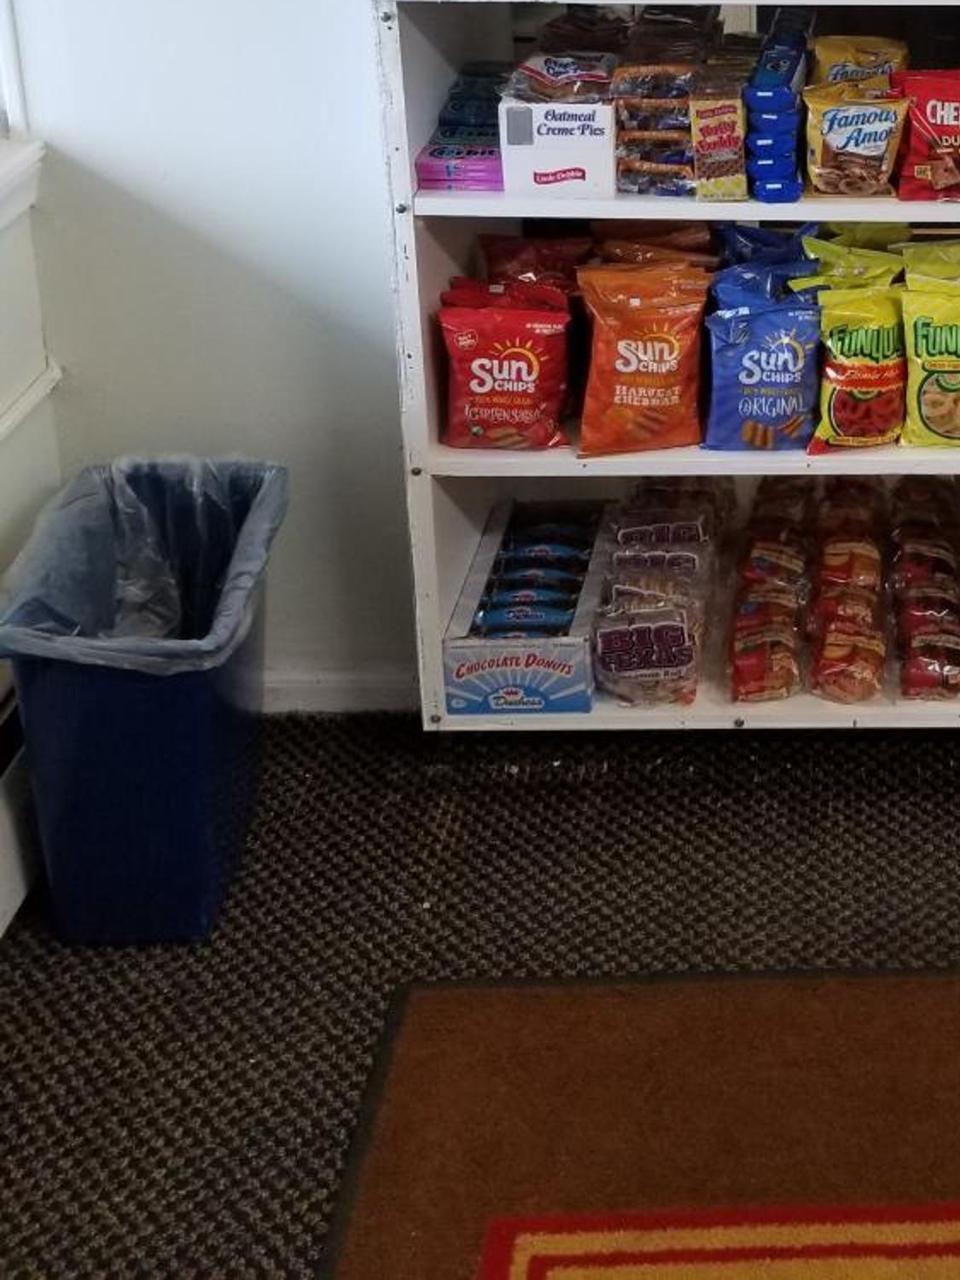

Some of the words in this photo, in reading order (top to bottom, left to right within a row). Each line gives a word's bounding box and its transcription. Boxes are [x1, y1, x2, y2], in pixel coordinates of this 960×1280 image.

[536, 122, 576, 136] Creme
[577, 122, 605, 136] Pies
[544, 110, 596, 122] Oatmeal
[822, 108, 898, 136] Famous
[615, 339, 679, 373] Sun
[830, 325, 904, 362] FUNYU
[469, 357, 539, 393] Sun
[739, 349, 803, 385] Sun
[762, 371, 801, 383] CHIPS
[494, 380, 536, 393] CHIPS
[455, 656, 522, 679] CHOCOLATE
[524, 653, 574, 675] DONUTS
